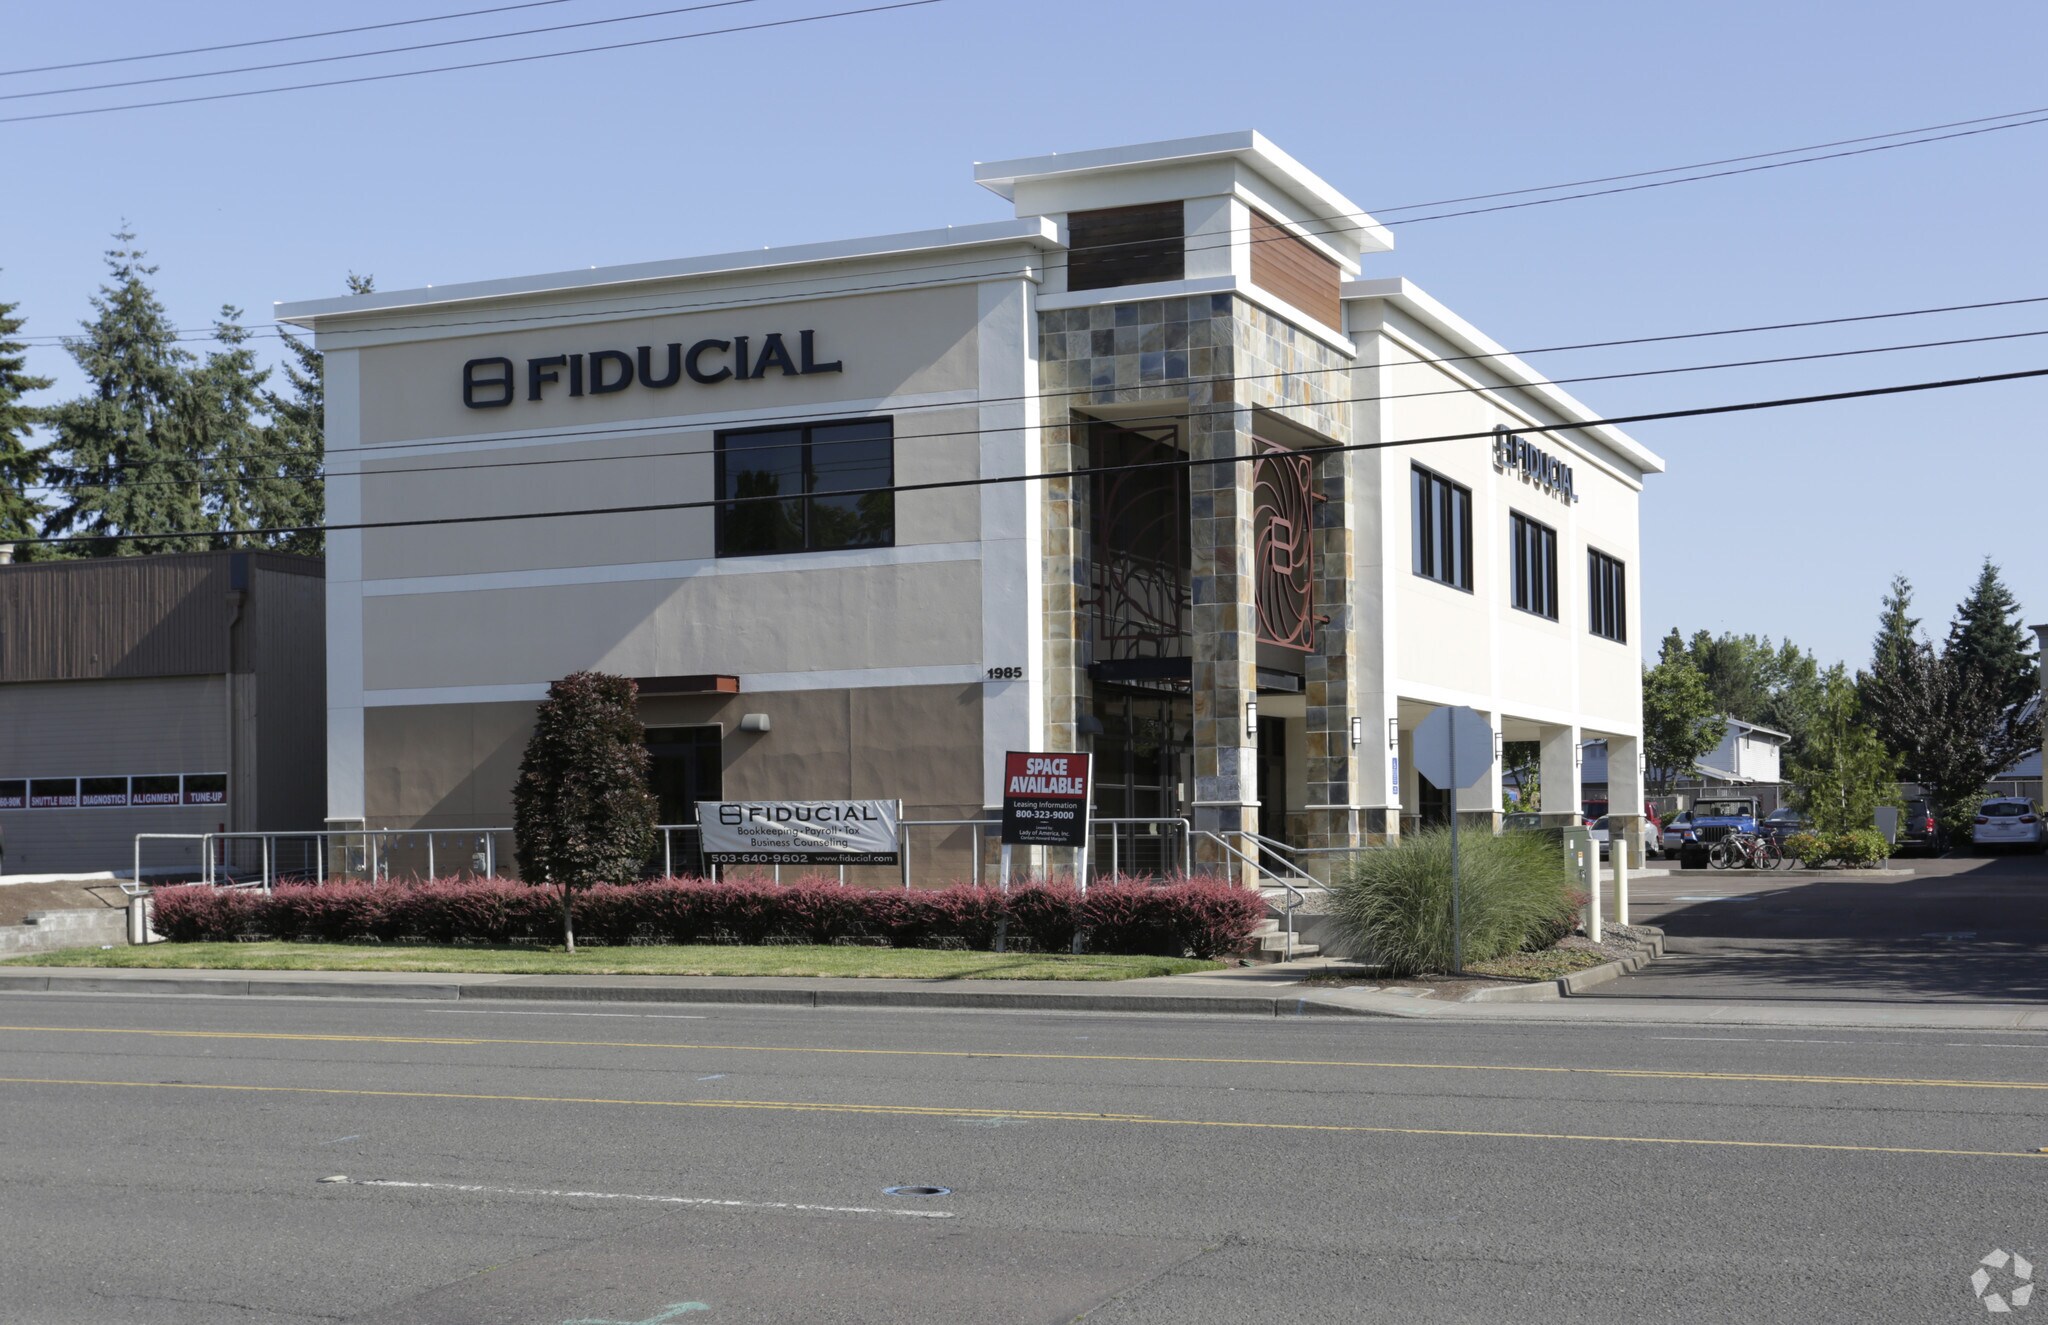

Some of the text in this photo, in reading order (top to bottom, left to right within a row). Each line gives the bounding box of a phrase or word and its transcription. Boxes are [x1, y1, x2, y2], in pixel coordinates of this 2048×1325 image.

[527, 329, 843, 401] FIDUCIAL
[987, 666, 1023, 680] 1985
[1026, 758, 1068, 775] SPACE
[1009, 776, 1083, 794] AVAILABLE
[31, 796, 58, 806] SHUTTLE
[82, 794, 126, 805] DIAGNOSTICS
[133, 793, 179, 804] ALIGNMENT
[190, 792, 223, 803] TUNE-UP
[1013, 801, 1078, 809] Leasing Information
[749, 806, 878, 822] FIDUCIAL
[1015, 810, 1074, 819] 800-323-9000
[737, 825, 860, 837] Bookkeeping Payroll Tax
[750, 837, 848, 848] Business Counseling
[711, 853, 893, 863] 503-640-9602 www.fiducial.com
